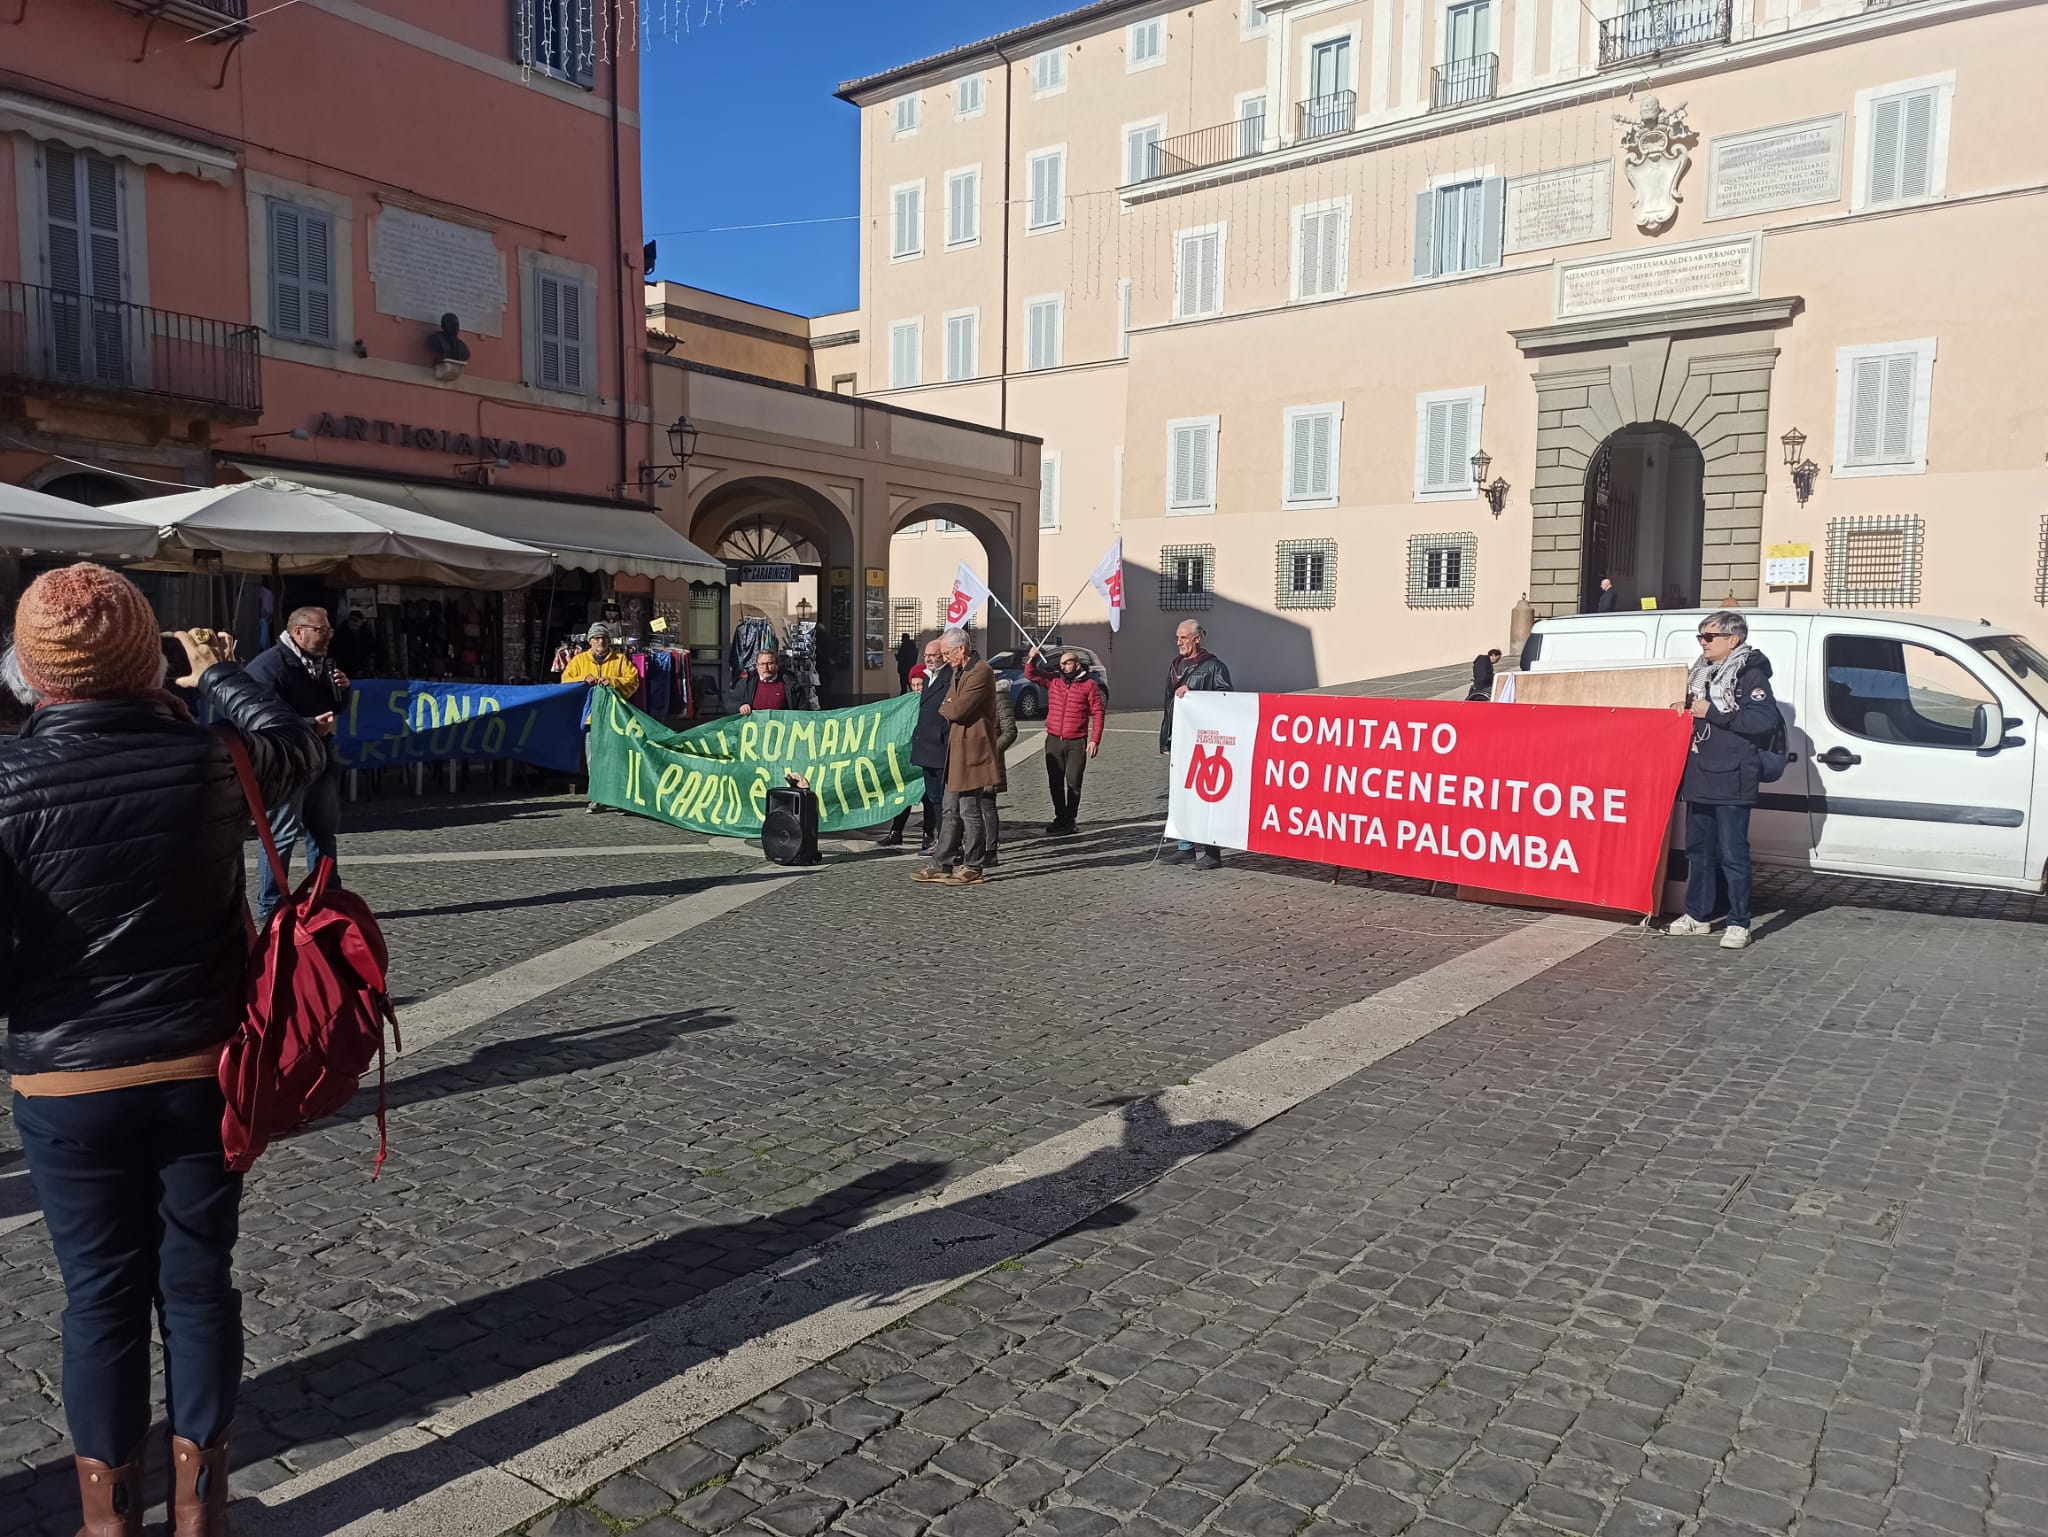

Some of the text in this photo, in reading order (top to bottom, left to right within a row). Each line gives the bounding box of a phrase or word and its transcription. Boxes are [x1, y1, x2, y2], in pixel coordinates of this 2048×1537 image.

[317, 412, 567, 468] ARTIGIANATO
[752, 567, 791, 579] CARABINIERI
[740, 712, 881, 763] ROMANI
[1271, 713, 1457, 754] COMITATO
[625, 749, 647, 806] IL
[655, 763, 743, 825] PARCO
[1183, 744, 1233, 803] NO
[1264, 758, 1628, 824] NO INCENERITORE
[1261, 804, 1580, 873] A SANTA PALOMBA
